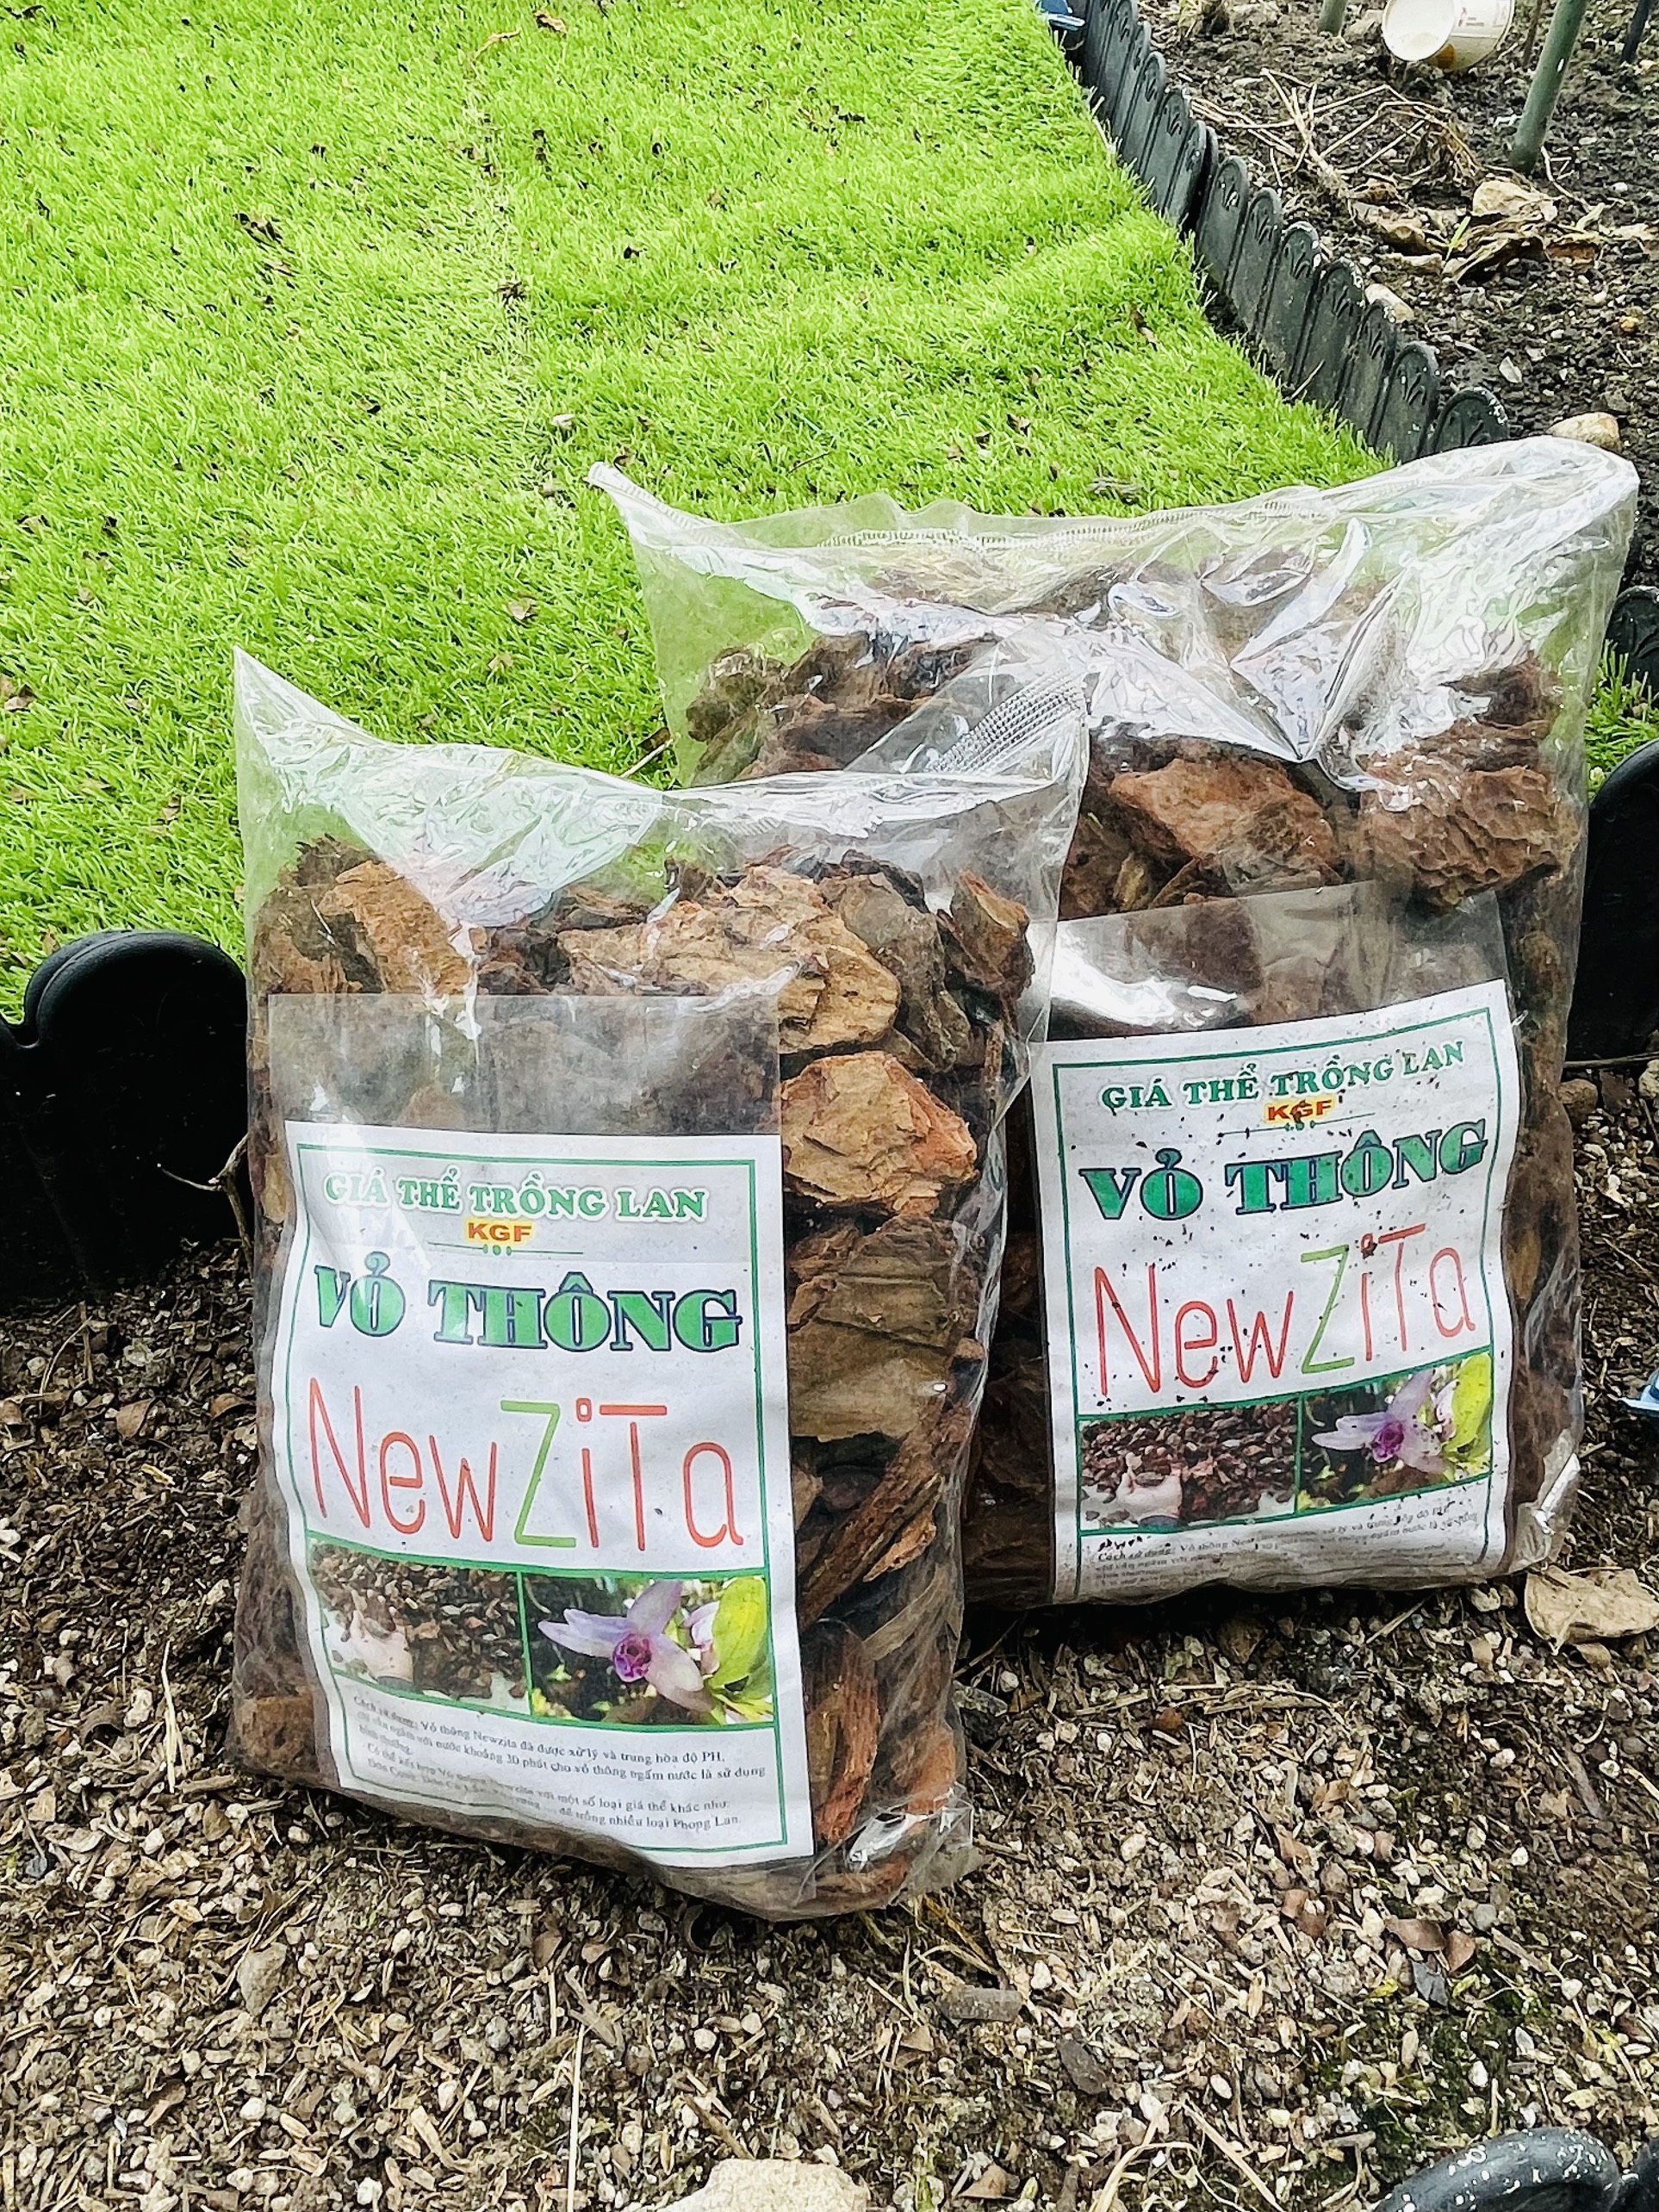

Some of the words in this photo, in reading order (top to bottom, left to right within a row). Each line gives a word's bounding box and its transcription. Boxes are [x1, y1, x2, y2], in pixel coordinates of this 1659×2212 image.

[1102, 1078, 1171, 1109] GIÁ
[1184, 1064, 1259, 1103] THỂ
[1271, 1054, 1394, 1097] TRỒNG
[1403, 1041, 1464, 1075] LAN
[1268, 1100, 1333, 1122] KGF
[1079, 1148, 1202, 1220] VỎ
[1225, 1119, 1488, 1215] THÔNG
[398, 1167, 461, 1209] THỂ
[470, 1174, 606, 1216] TRỒNG
[618, 1190, 705, 1218] LAN
[468, 1222, 532, 1242] KGF
[314, 1252, 406, 1337] VỎ
[428, 1271, 743, 1351] THÔNG
[420, 1721, 437, 1734] Vỏ
[440, 1725, 470, 1741] thông
[537, 1743, 565, 1757] được
[603, 1749, 617, 1760] và
[621, 1752, 652, 1766] trung
[656, 1752, 680, 1764] hòa
[682, 1752, 699, 1765] độ
[464, 1743, 503, 1765] khoảng
[523, 1758, 548, 1771] phút
[550, 1762, 571, 1773] cho
[575, 1762, 590, 1774] vỏ
[593, 1765, 627, 1780] thông
[631, 1768, 664, 1782] ngấm
[668, 1770, 697, 1781] nước
[701, 1768, 713, 1780] là
[717, 1767, 731, 1779] sử
[735, 1767, 766, 1780] dụng
[558, 1793, 580, 1806] một
[582, 1794, 596, 1807] số
[599, 1798, 622, 1811] loại
[625, 1799, 644, 1813] giá
[648, 1799, 667, 1811] thể
[670, 1799, 700, 1813] khác
[575, 1809, 606, 1825] trồng
[609, 1814, 643, 1827] nhiều
[647, 1817, 670, 1831] loại
[674, 1817, 711, 1833] Phong
